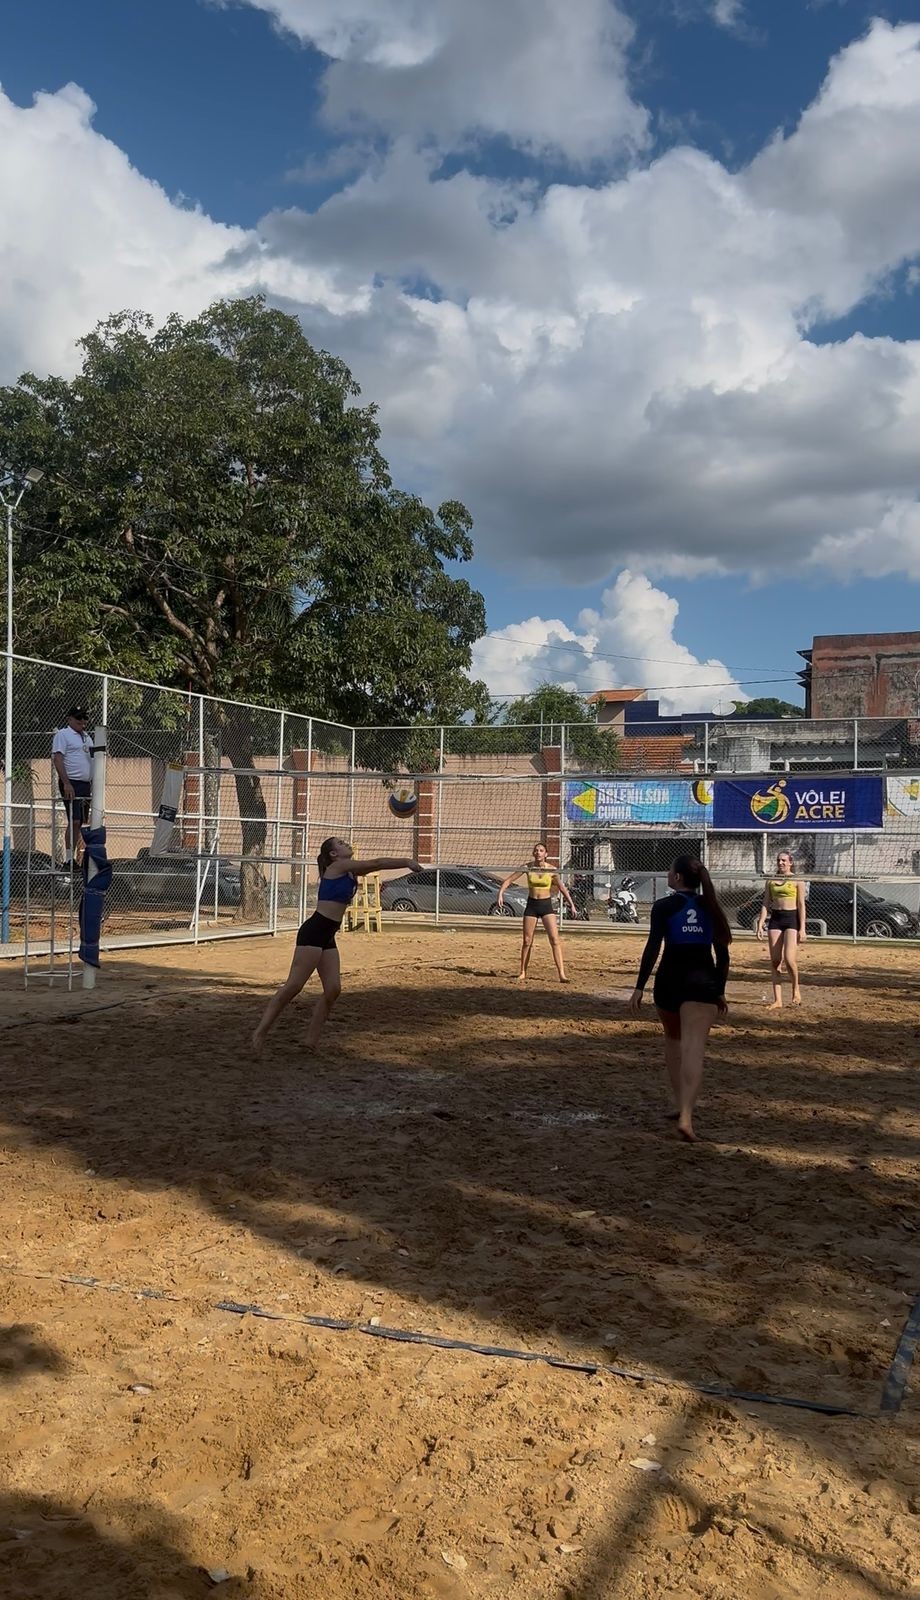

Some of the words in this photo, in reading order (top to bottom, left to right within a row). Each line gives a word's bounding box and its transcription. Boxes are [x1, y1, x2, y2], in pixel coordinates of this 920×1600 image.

[795, 789, 845, 804] VÔLEI
[597, 806, 632, 819] CUNHA
[795, 805, 845, 819] ACRE
[686, 909, 698, 923] 2
[682, 925, 703, 933] DUDA
